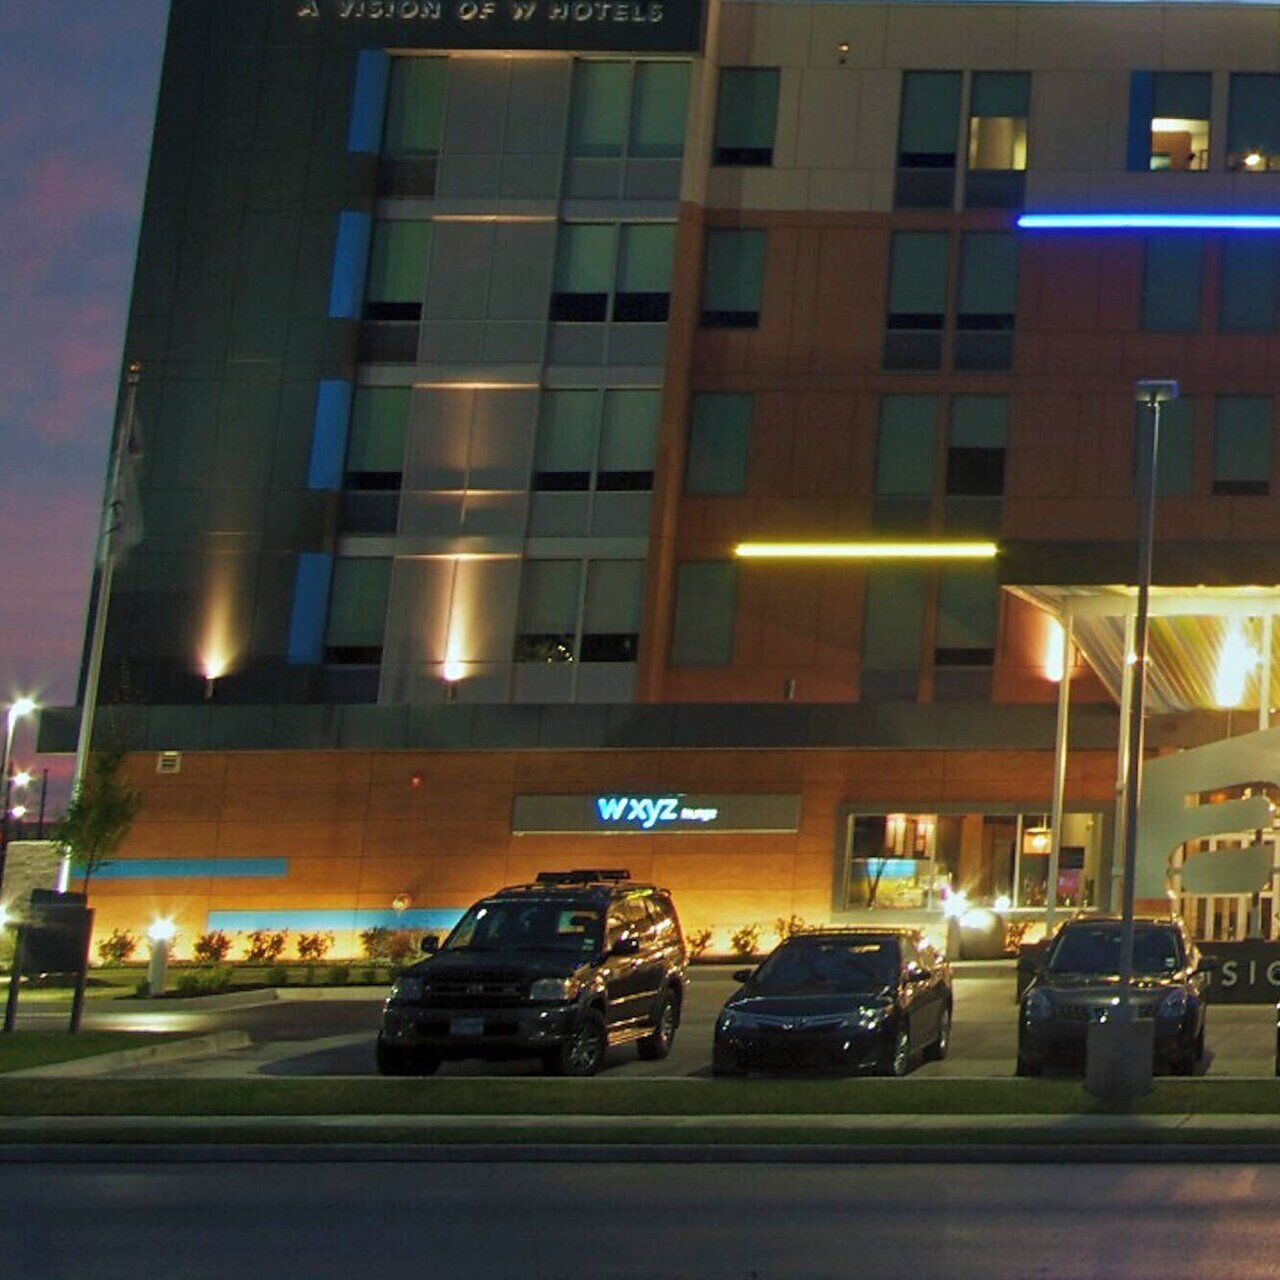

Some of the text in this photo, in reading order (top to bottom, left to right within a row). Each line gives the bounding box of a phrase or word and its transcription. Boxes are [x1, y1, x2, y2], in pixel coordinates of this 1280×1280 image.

[458, 0, 497, 21] OF
[510, 0, 537, 20] W
[548, 0, 665, 22] HOTELS
